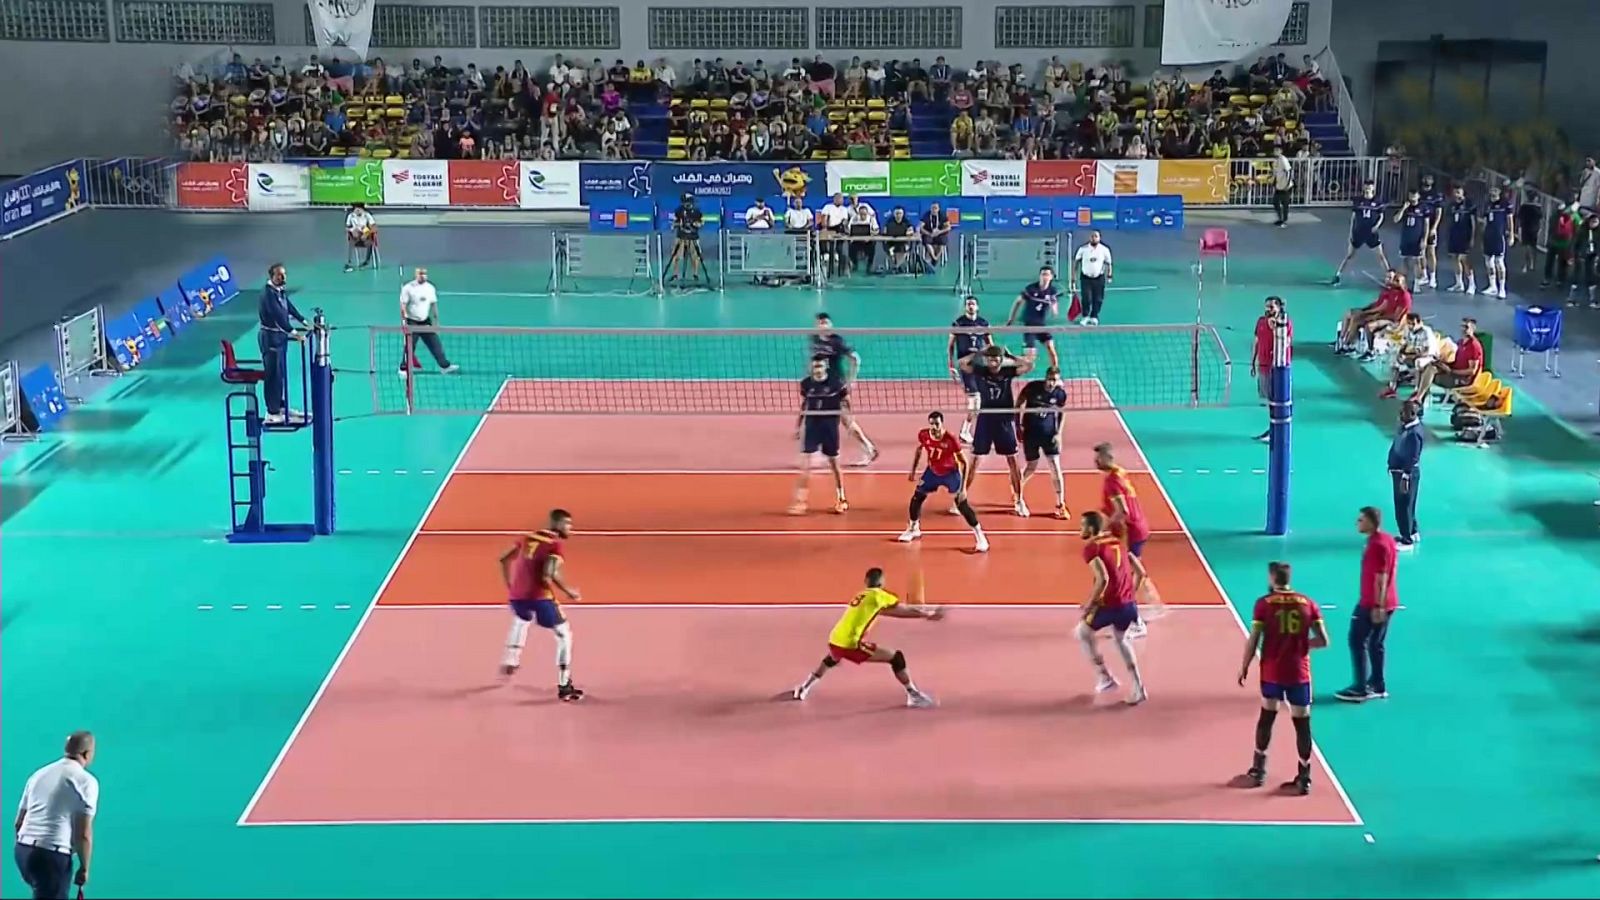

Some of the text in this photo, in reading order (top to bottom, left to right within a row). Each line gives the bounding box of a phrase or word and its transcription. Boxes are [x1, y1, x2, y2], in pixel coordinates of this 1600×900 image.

[672, 172, 753, 184] وهران في القلب
[989, 387, 1002, 399] 17
[928, 446, 943, 460] 77
[1110, 544, 1121, 568] 7
[1275, 609, 1301, 634] 16
